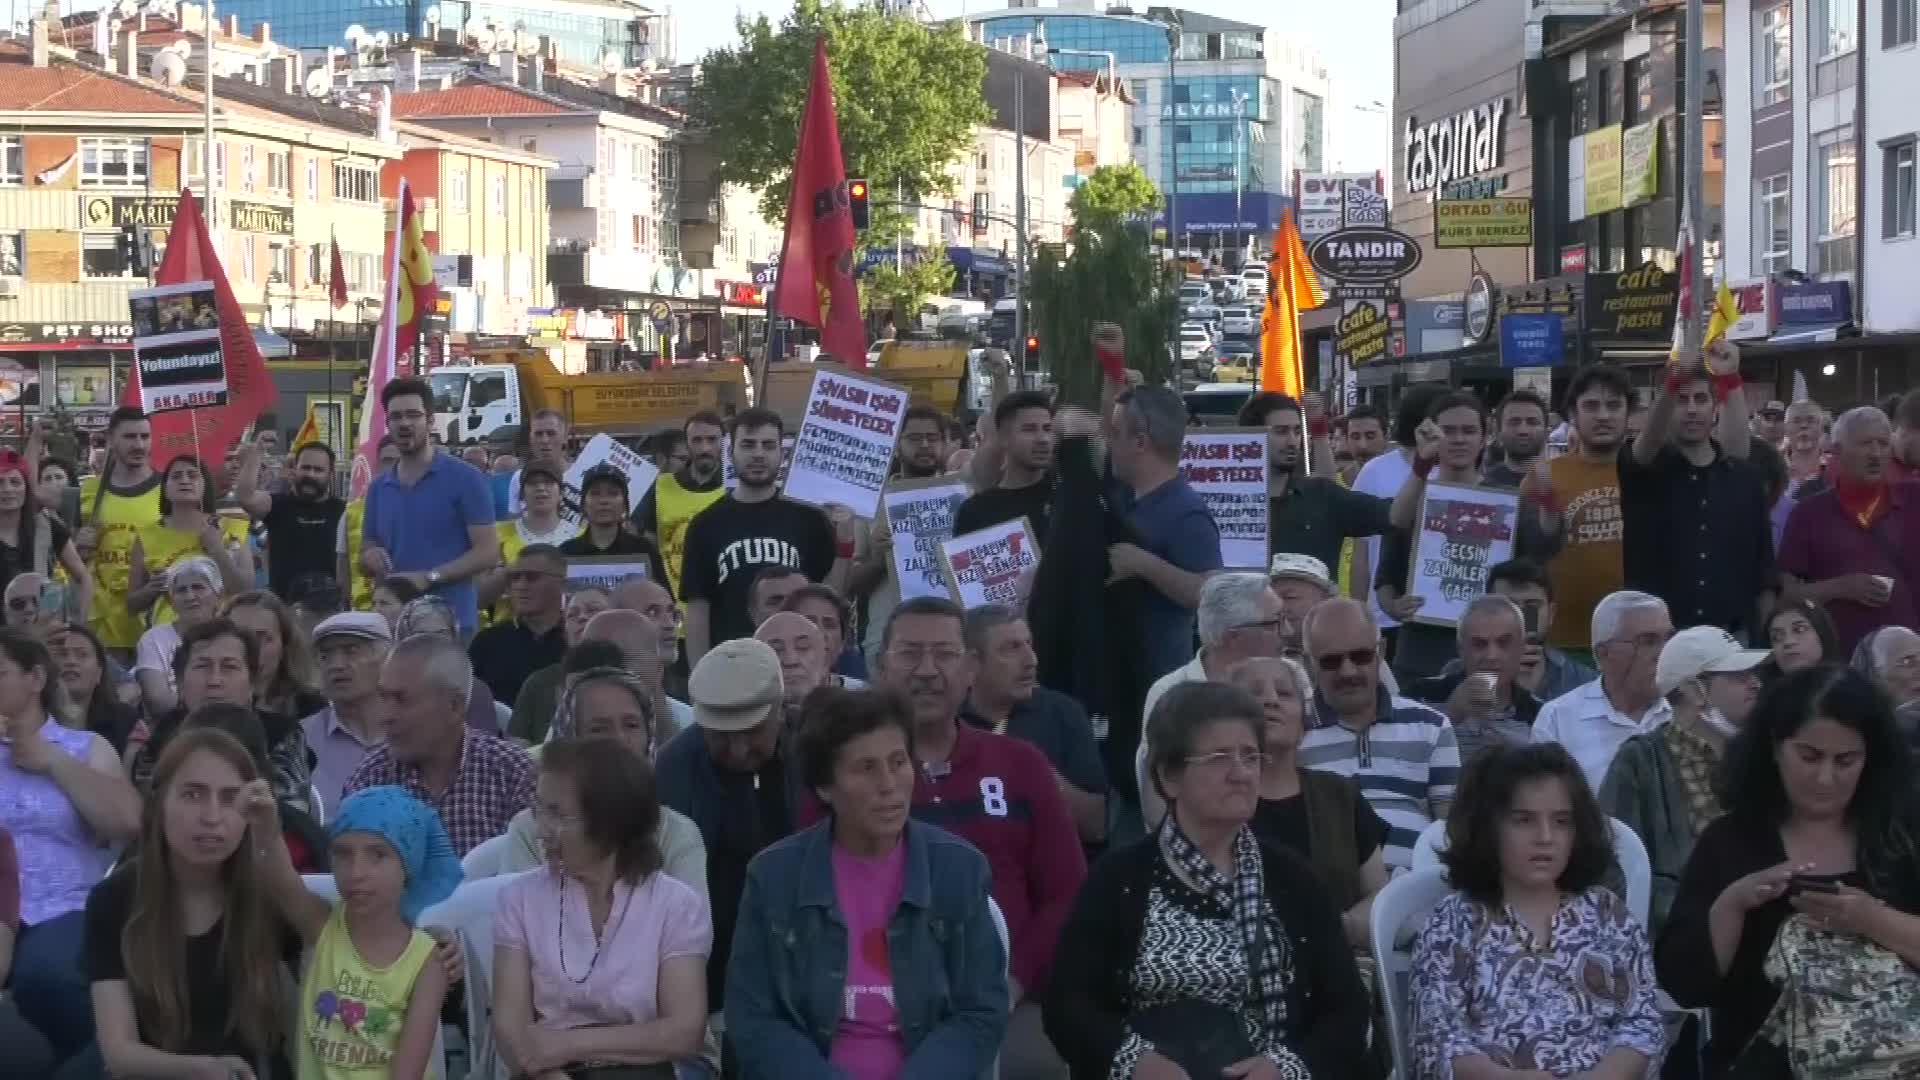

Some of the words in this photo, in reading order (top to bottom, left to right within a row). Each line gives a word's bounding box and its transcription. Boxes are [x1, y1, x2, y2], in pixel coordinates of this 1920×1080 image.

[1326, 242, 1406, 258] TANDIR
[42, 325, 83, 337] PET
[91, 325, 134, 337] SHO
[1616, 311, 1664, 334] pasta
[1183, 462, 1264, 484] ÖNMEYECEK
[979, 776, 1008, 816] 8
